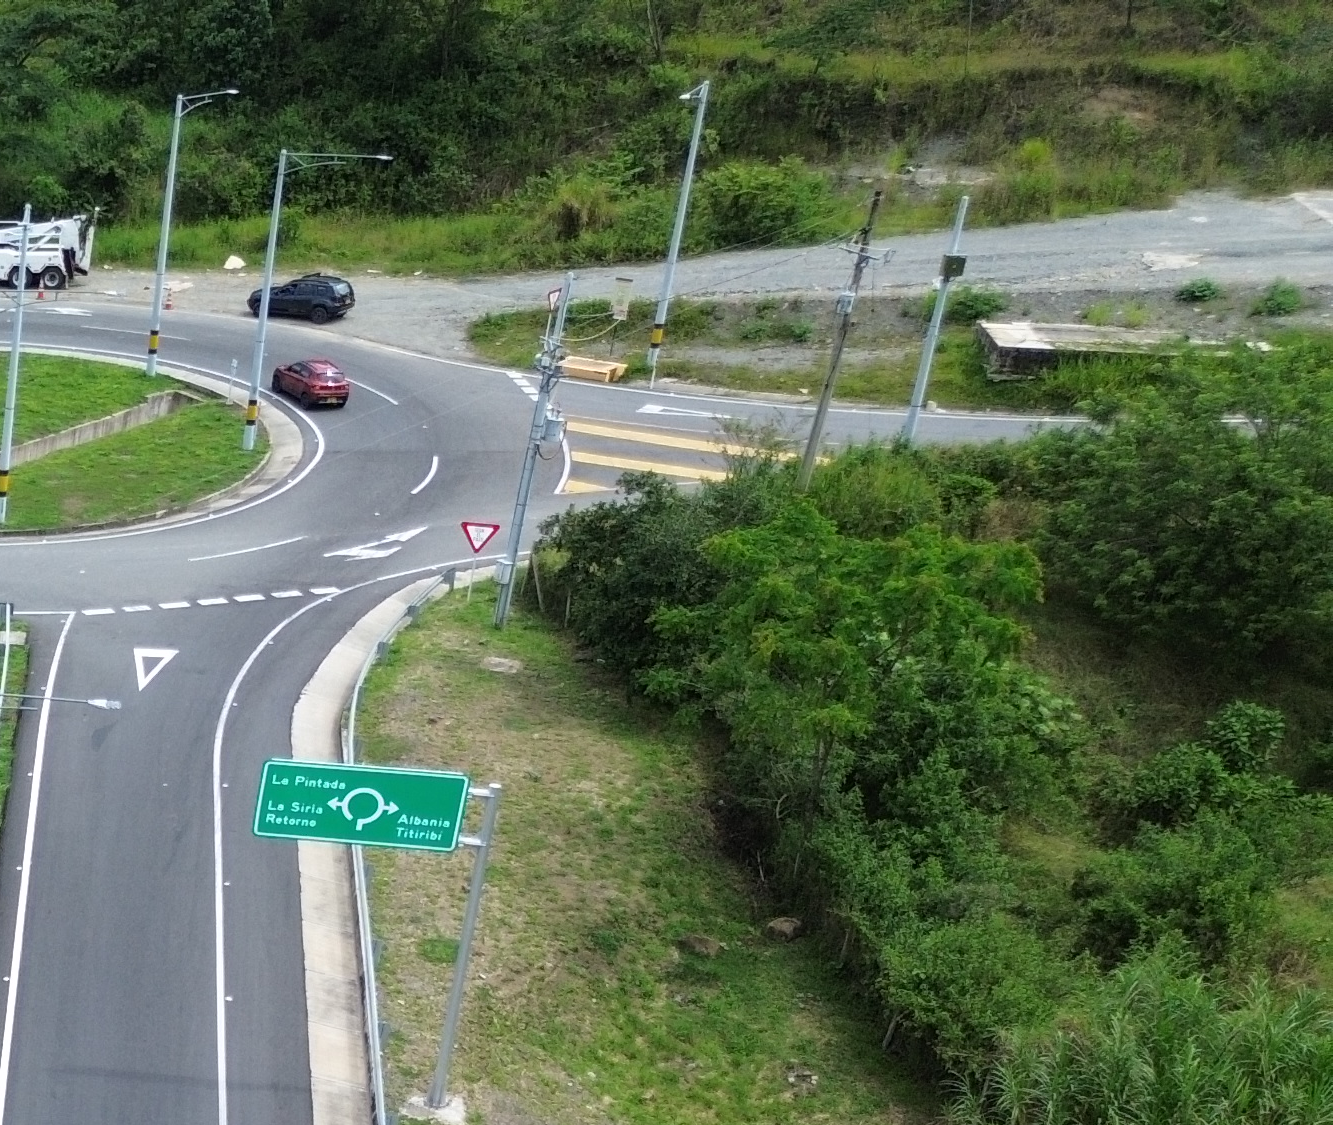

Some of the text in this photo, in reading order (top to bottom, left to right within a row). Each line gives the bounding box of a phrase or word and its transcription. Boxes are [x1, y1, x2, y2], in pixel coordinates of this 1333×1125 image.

[272, 774, 346, 790] La Pintada
[267, 800, 323, 815] La Siria
[265, 813, 317, 828] Retorno
[397, 813, 451, 828] Albania
